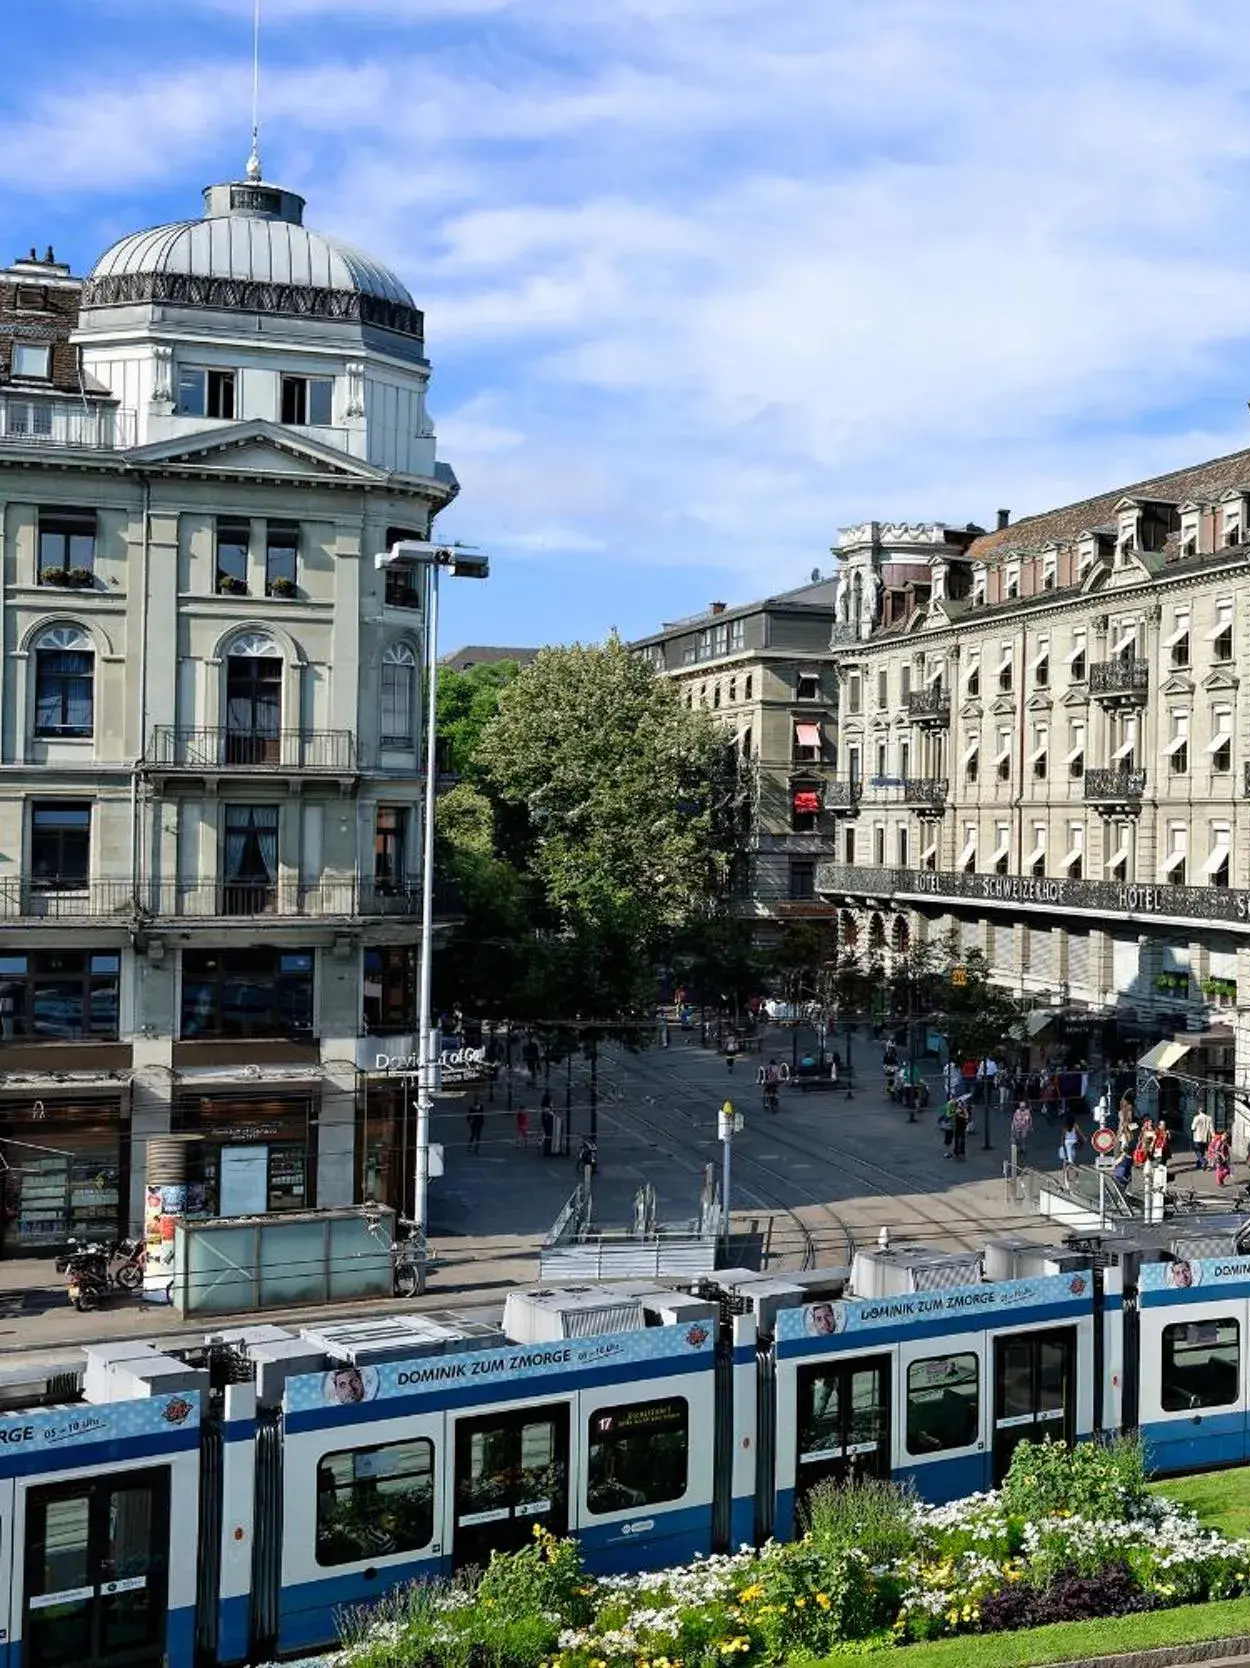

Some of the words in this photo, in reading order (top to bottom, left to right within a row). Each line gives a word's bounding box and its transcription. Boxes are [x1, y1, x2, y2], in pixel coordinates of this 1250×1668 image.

[983, 876, 1065, 902] SCHWEIZERHOF
[1119, 887, 1161, 910] HOTEL
[860, 1300, 915, 1321] DOMINIK
[917, 1299, 945, 1313] ZUM
[946, 1293, 997, 1309] ZMORGE
[397, 1362, 467, 1386] DOMINIK
[470, 1359, 505, 1376] ZUM
[509, 1349, 572, 1370] ZMORGE
[68, 1421, 80, 1433] 10
[598, 1416, 613, 1431] 17
